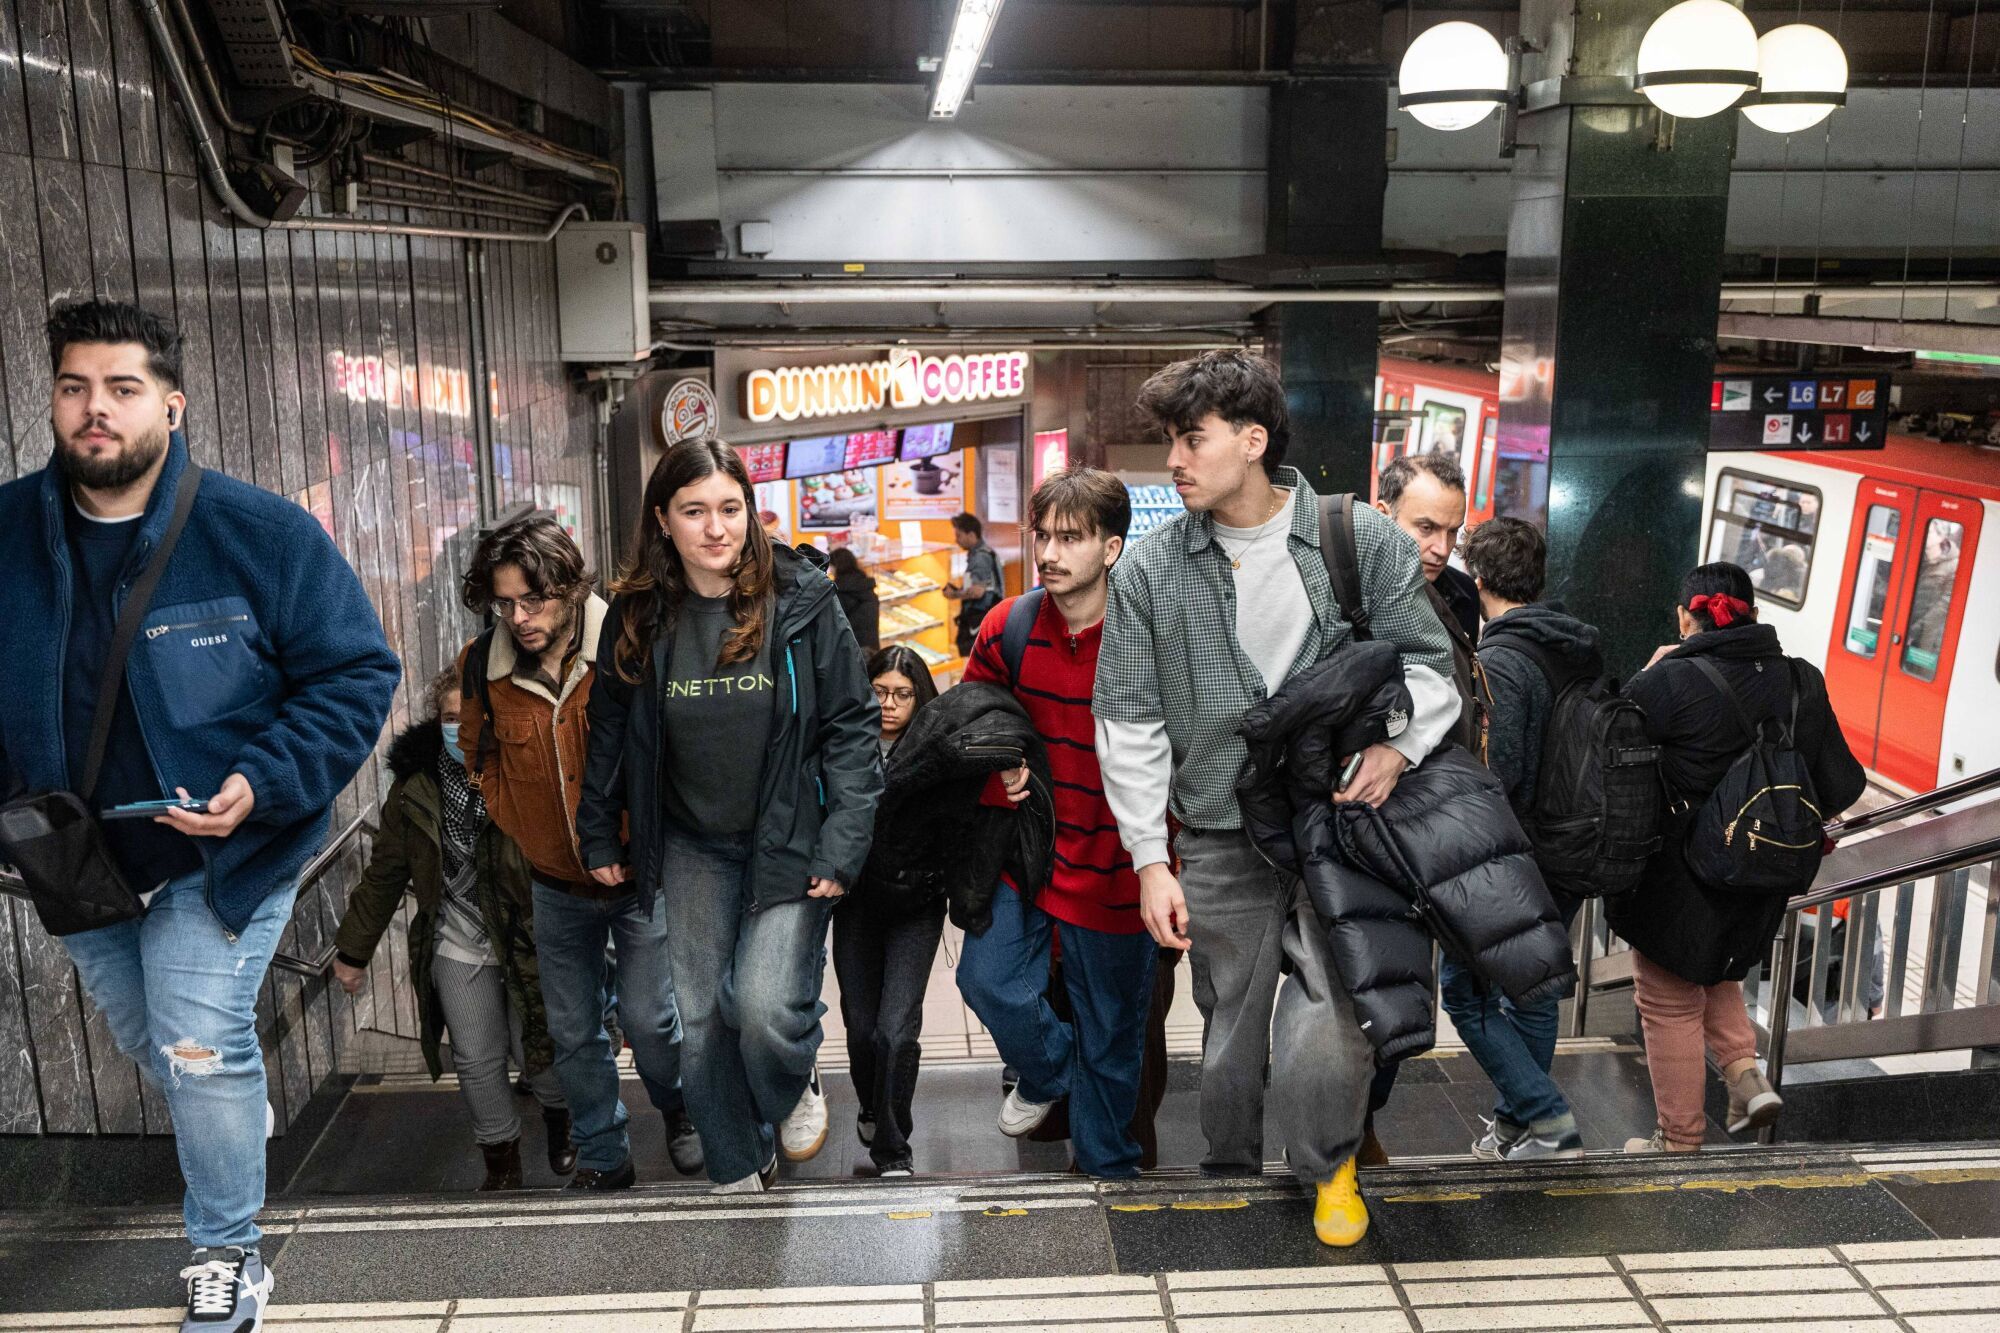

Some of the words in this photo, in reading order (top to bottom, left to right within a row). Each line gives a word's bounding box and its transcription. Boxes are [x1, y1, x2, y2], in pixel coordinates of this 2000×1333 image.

[750, 364, 891, 418] DUNKIN'
[922, 356, 1022, 400] COFFEE
[1791, 386, 1814, 403] L6
[1820, 386, 1844, 403] L7
[1823, 424, 1844, 441] L1
[190, 634, 228, 648] GUESS
